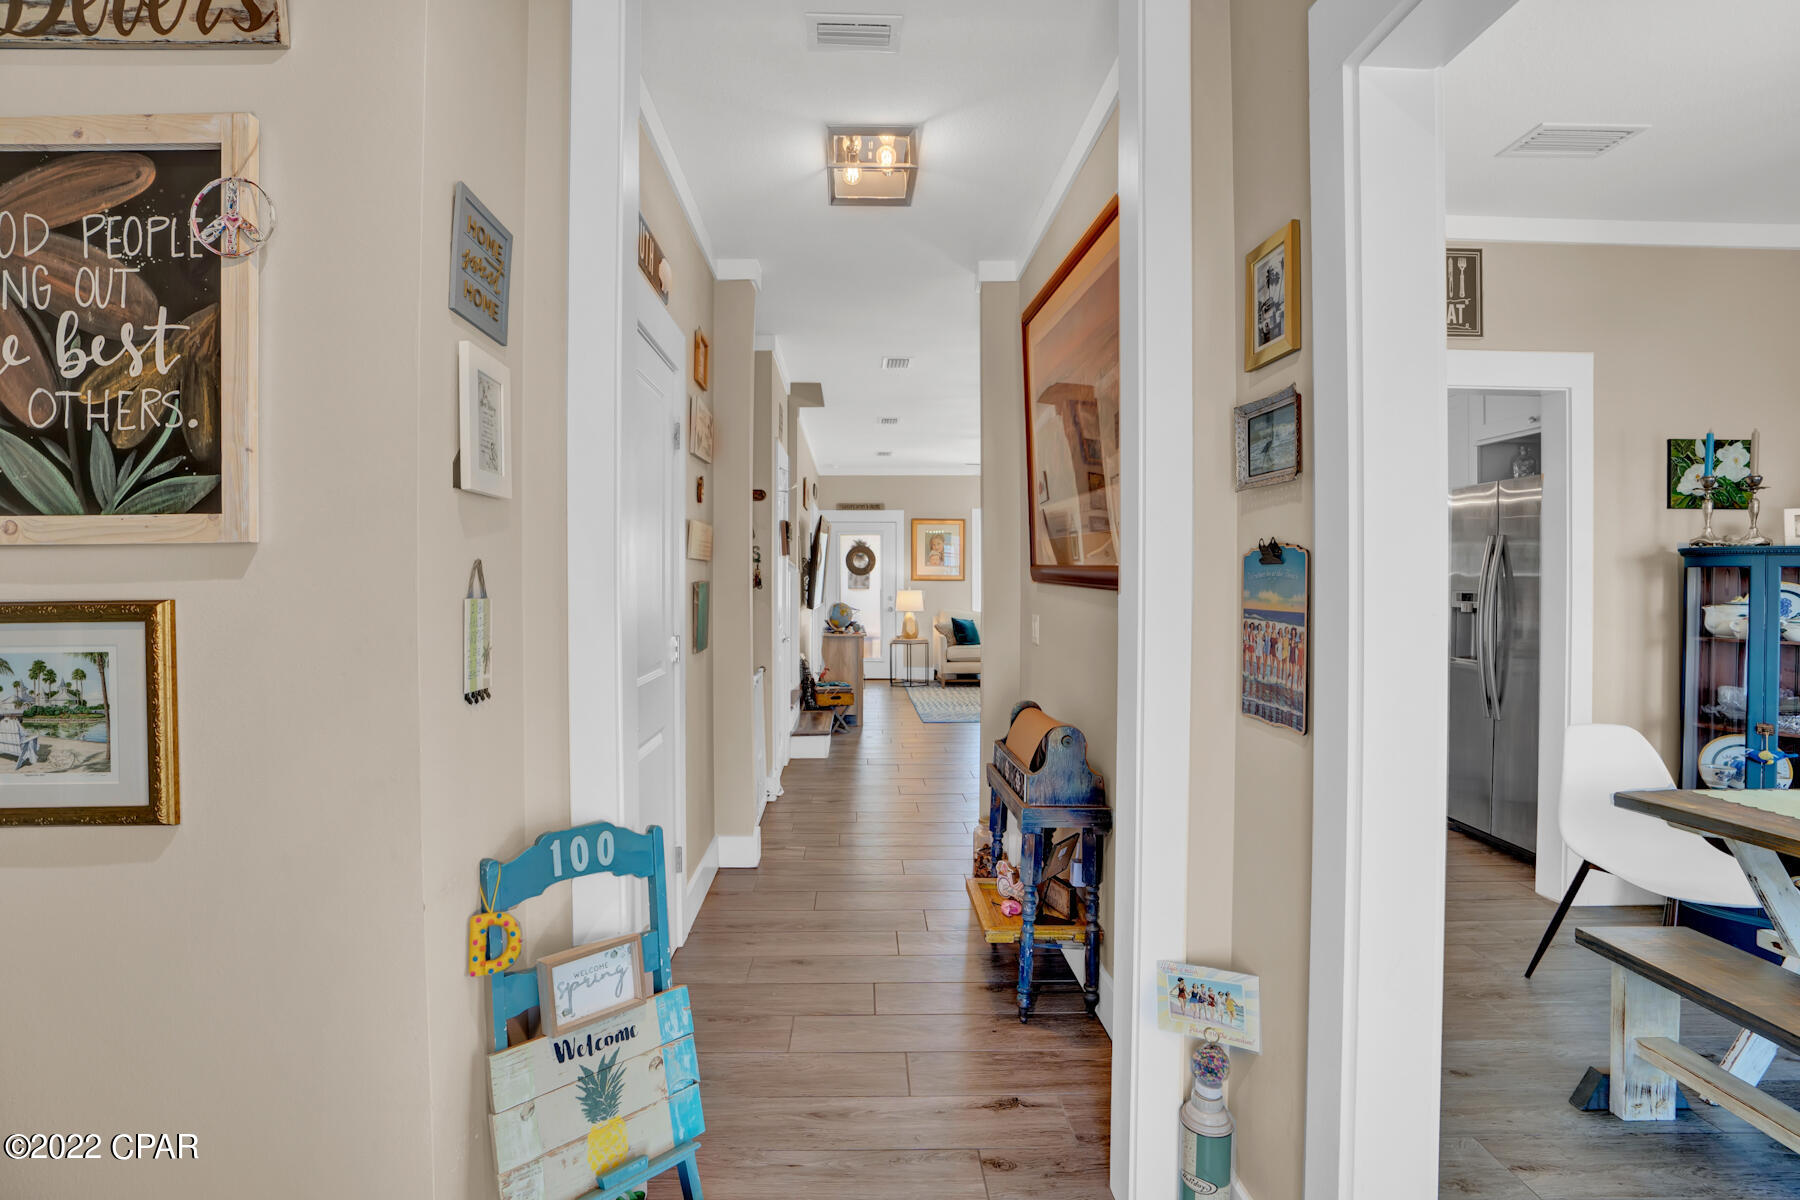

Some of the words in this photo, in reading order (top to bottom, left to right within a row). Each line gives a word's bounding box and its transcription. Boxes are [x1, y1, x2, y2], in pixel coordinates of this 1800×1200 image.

[82, 214, 204, 260] PEOPLE
[467, 215, 503, 261] HOME
[74, 266, 140, 310] OUT
[463, 279, 499, 323] HOME
[1447, 303, 1466, 324] AT
[56, 306, 190, 379] best
[28, 387, 199, 432] OTHERS.
[550, 830, 615, 877] 100
[468, 912, 522, 976] D
[573, 961, 609, 979] WELCOME
[553, 1024, 639, 1064] Welcome
